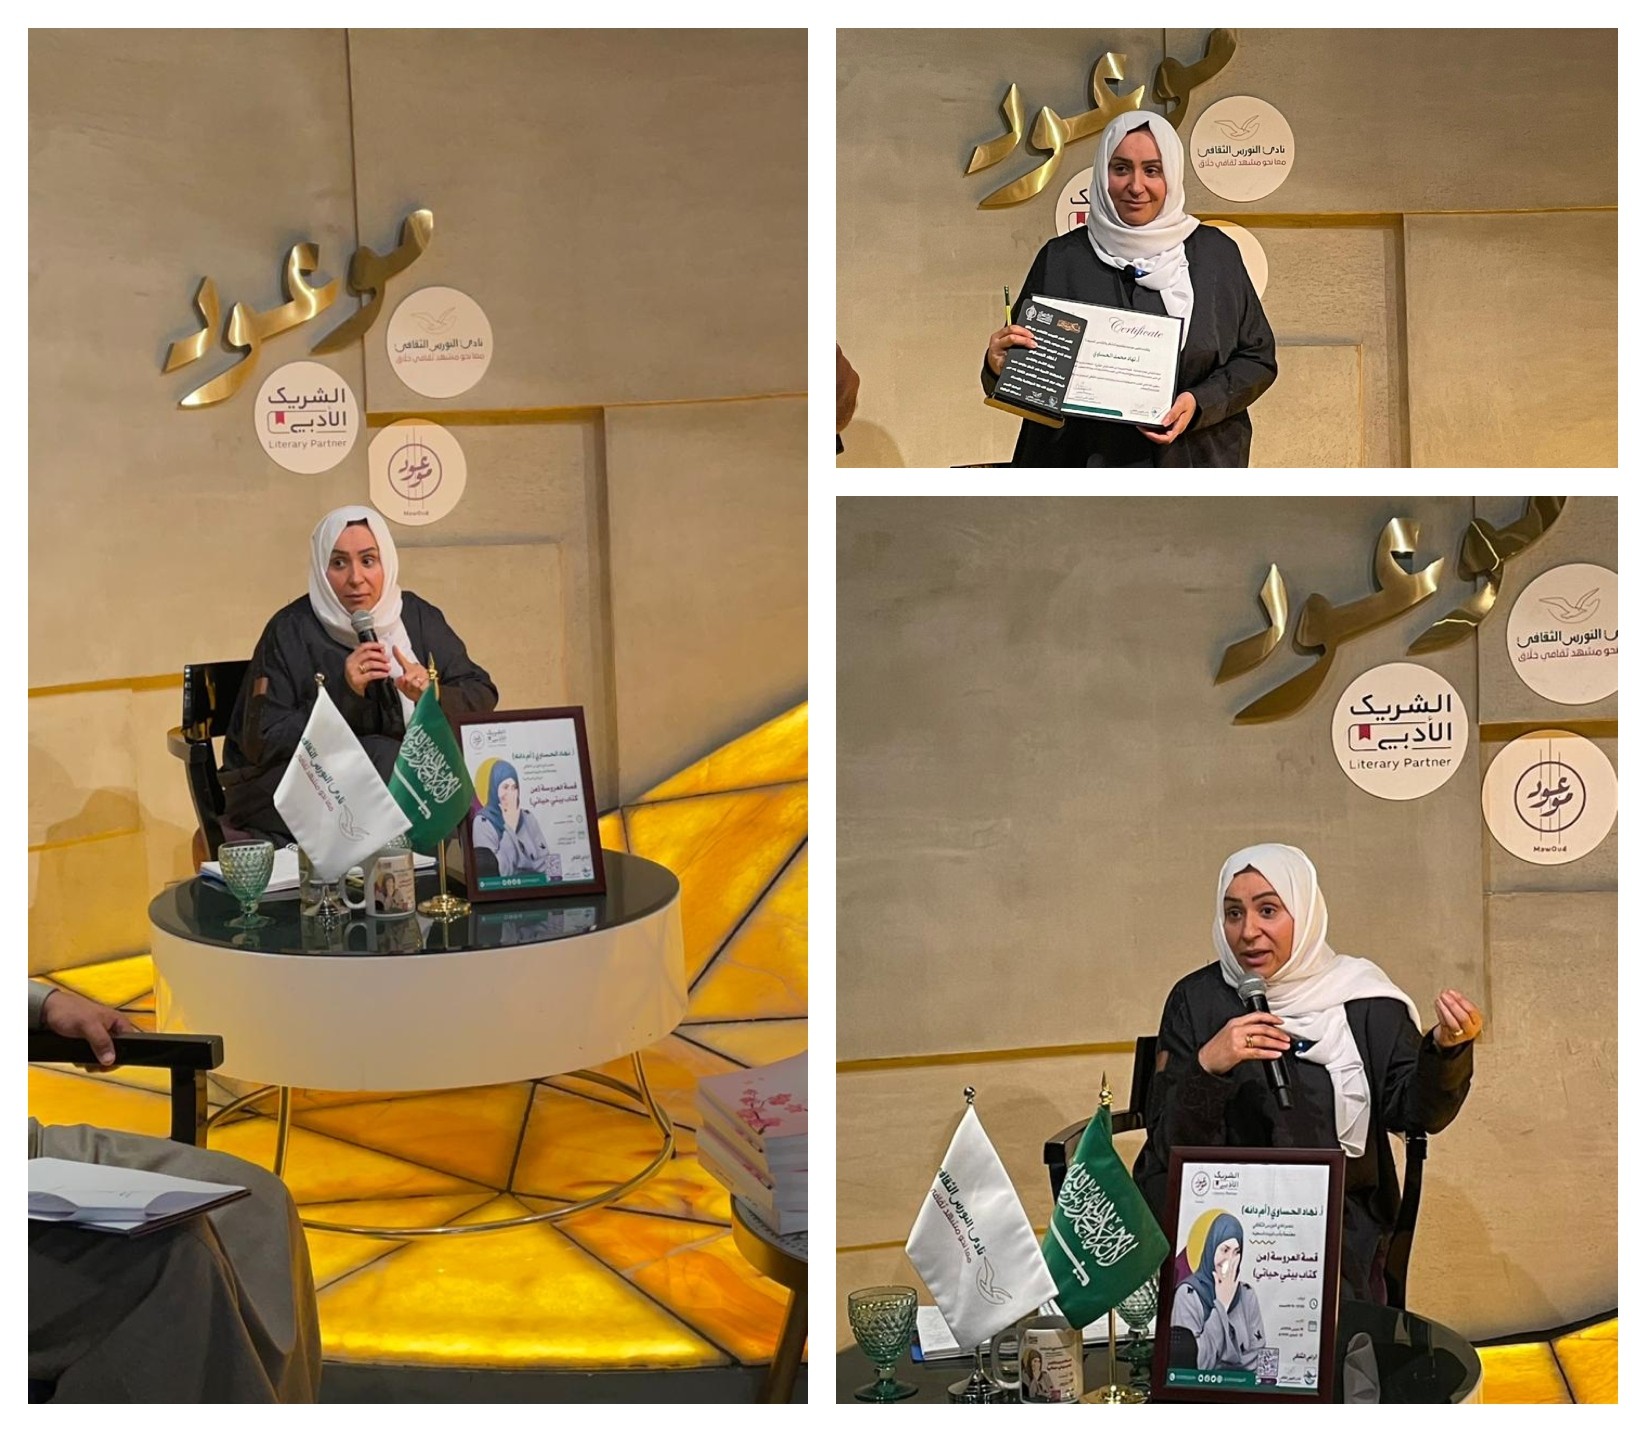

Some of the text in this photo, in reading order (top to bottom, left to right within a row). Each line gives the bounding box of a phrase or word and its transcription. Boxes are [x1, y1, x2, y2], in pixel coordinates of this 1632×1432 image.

[1197, 144, 1231, 157] الثقافي
[1232, 145, 1260, 157] النورس
[1109, 316, 1164, 339] Certificate
[268, 387, 345, 409] الشريك
[290, 406, 346, 433] الأدبي
[269, 439, 347, 450] Literary Partner
[1517, 631, 1561, 648] الثقافي
[1562, 629, 1602, 646] النورس
[1350, 694, 1451, 721] الشريك
[1378, 716, 1451, 750] الأدبي
[1349, 758, 1451, 771] Literary Partner
[948, 1197, 974, 1228] النورس
[1271, 1207, 1301, 1219] الحساوي
[1302, 1207, 1317, 1216] نهاد
[1271, 1251, 1301, 1264] العروسة
[1301, 1252, 1318, 1262] قصة
[1280, 1269, 1298, 1283] بيتي
[1299, 1269, 1318, 1281] كتاب
